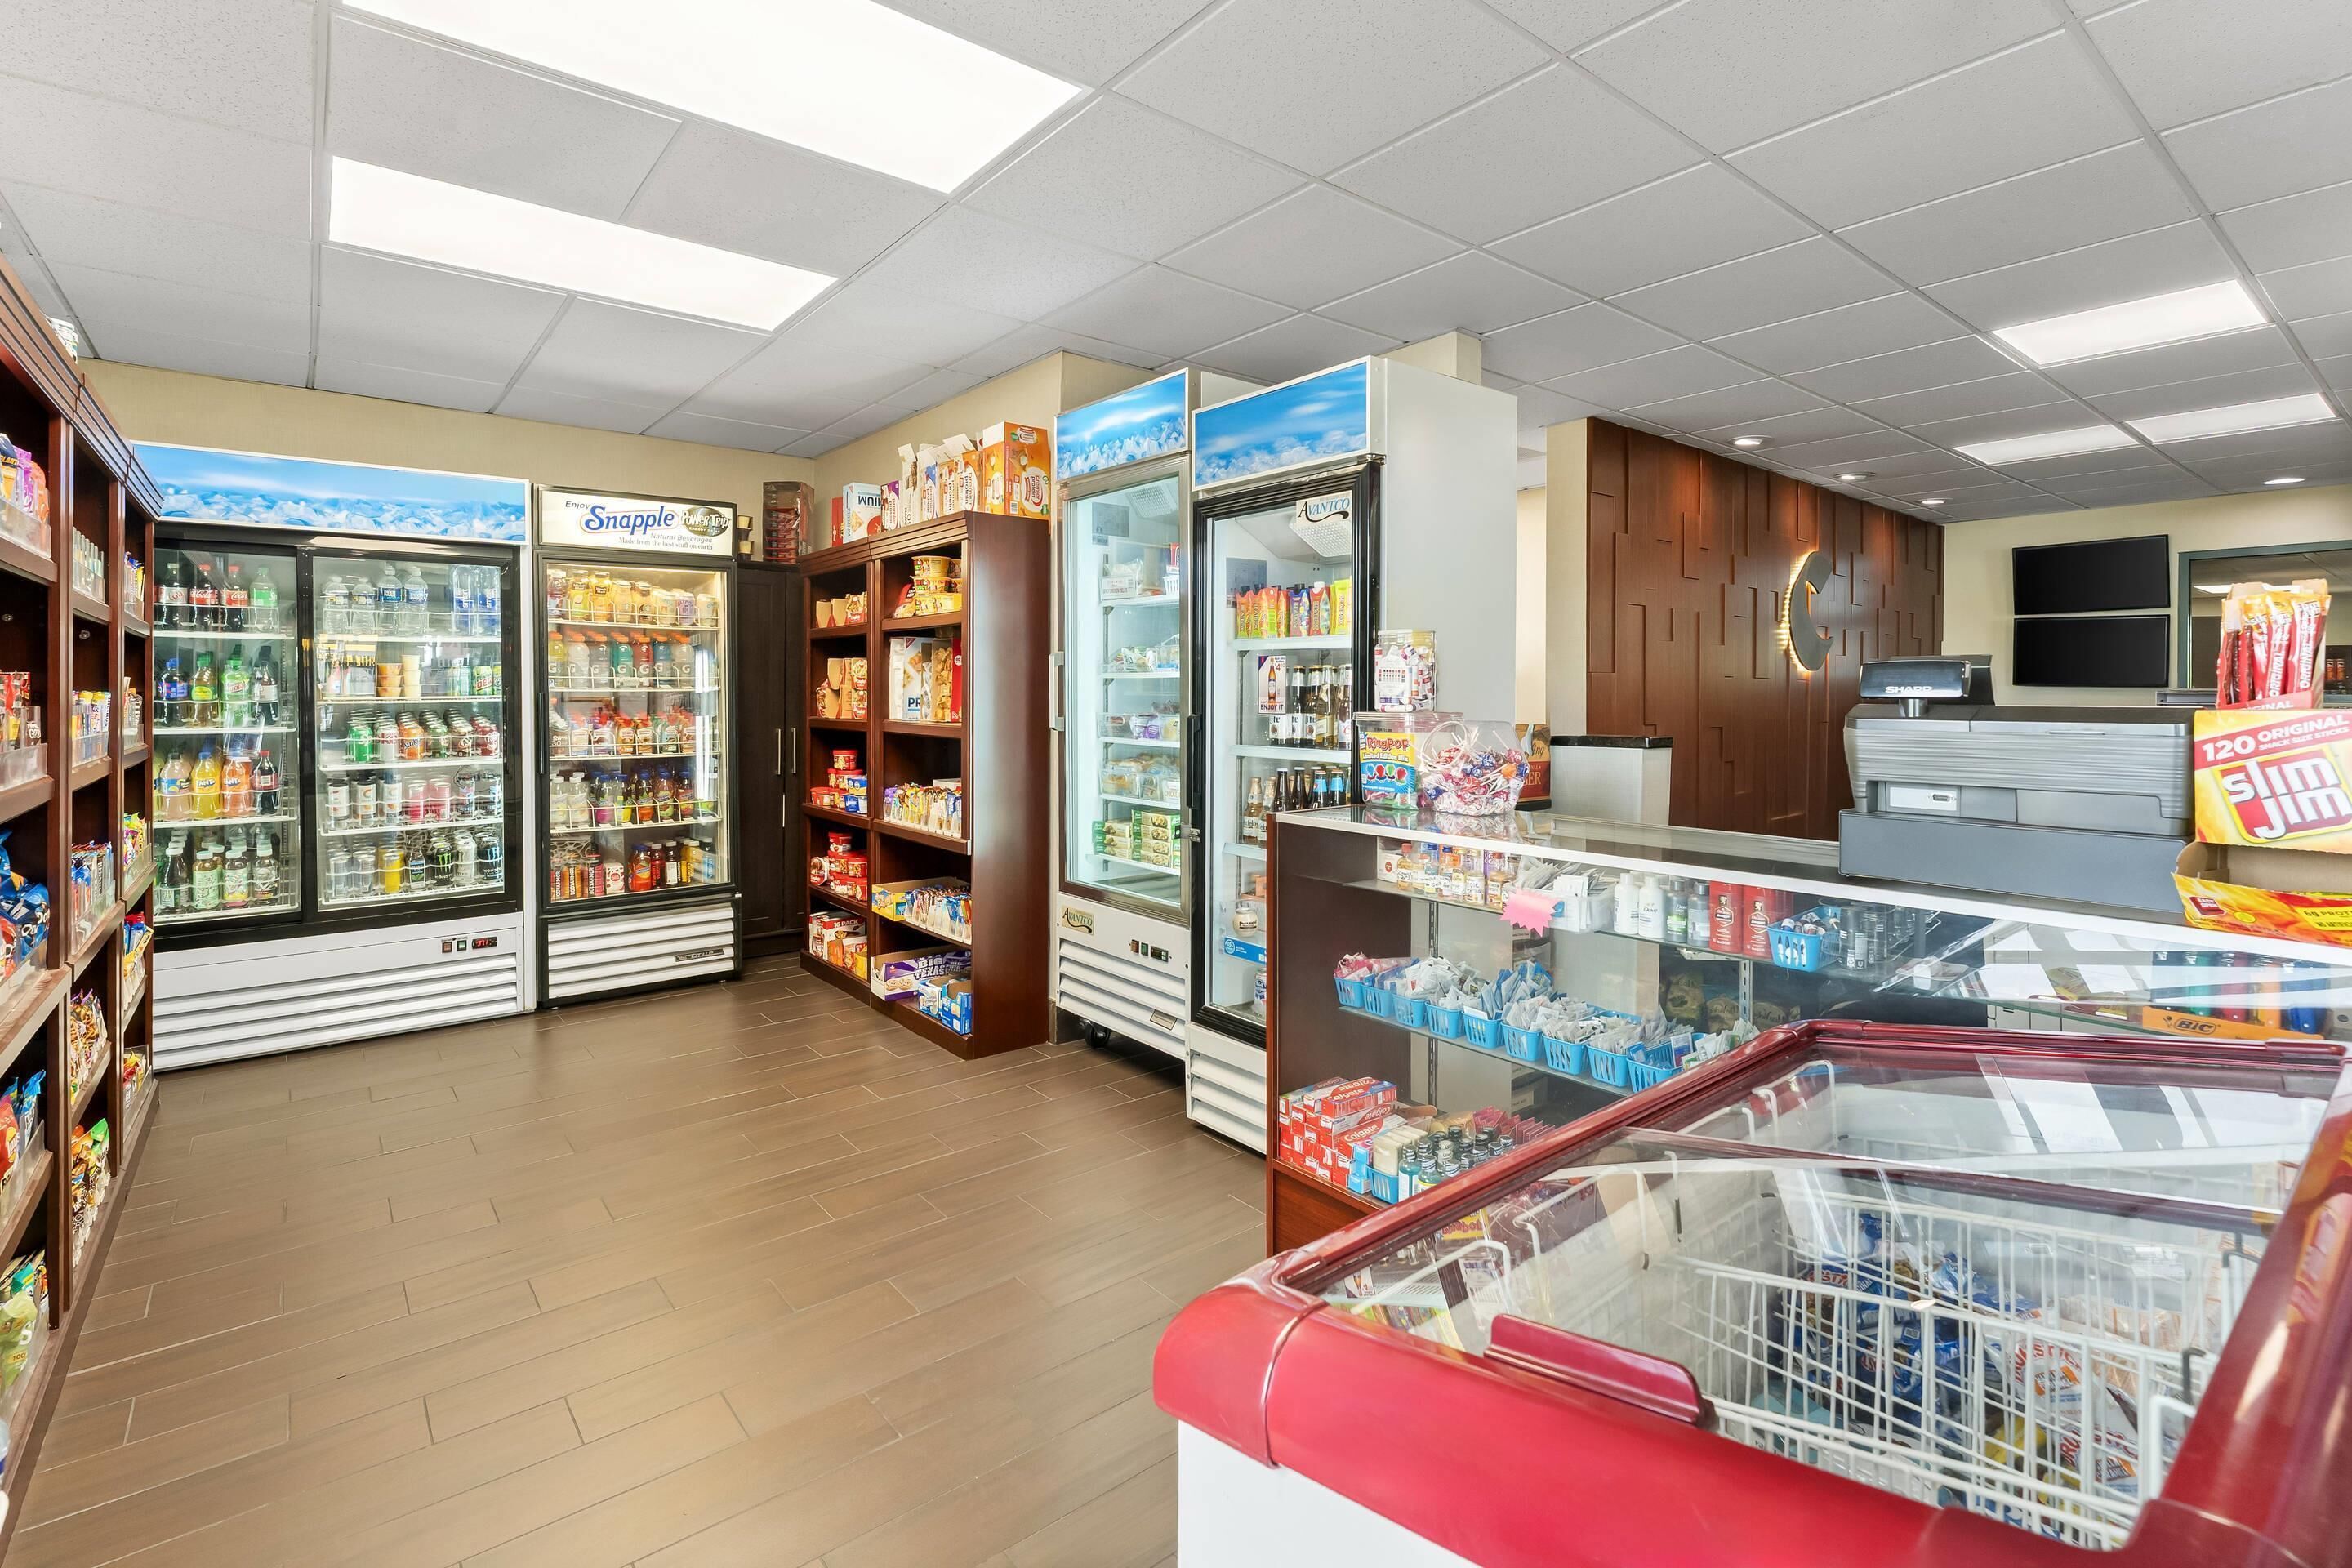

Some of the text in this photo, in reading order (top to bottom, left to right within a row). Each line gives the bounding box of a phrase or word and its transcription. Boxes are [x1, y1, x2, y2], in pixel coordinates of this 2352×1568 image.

[565, 500, 590, 510] Enjoy
[1298, 497, 1350, 519] AVANTCO
[585, 505, 675, 536] Snapple
[651, 532, 713, 544] Natural Beverages
[1885, 685, 1933, 693] SHARP
[2203, 715, 2349, 761] 120 ORIGINAL
[2258, 726, 2349, 751] SNACK SIZE STICKS
[841, 918, 859, 927] PACK
[1062, 907, 1093, 928] AVANTCO
[917, 956, 942, 969] BIG
[914, 964, 946, 980] TEXAS
[2177, 1019, 2216, 1033] BIC
[1339, 1076, 1376, 1093] Colgate
[1327, 1086, 1365, 1103] Colgate
[1363, 1105, 1391, 1120] Colgate
[1343, 1124, 1379, 1143] Colgate
